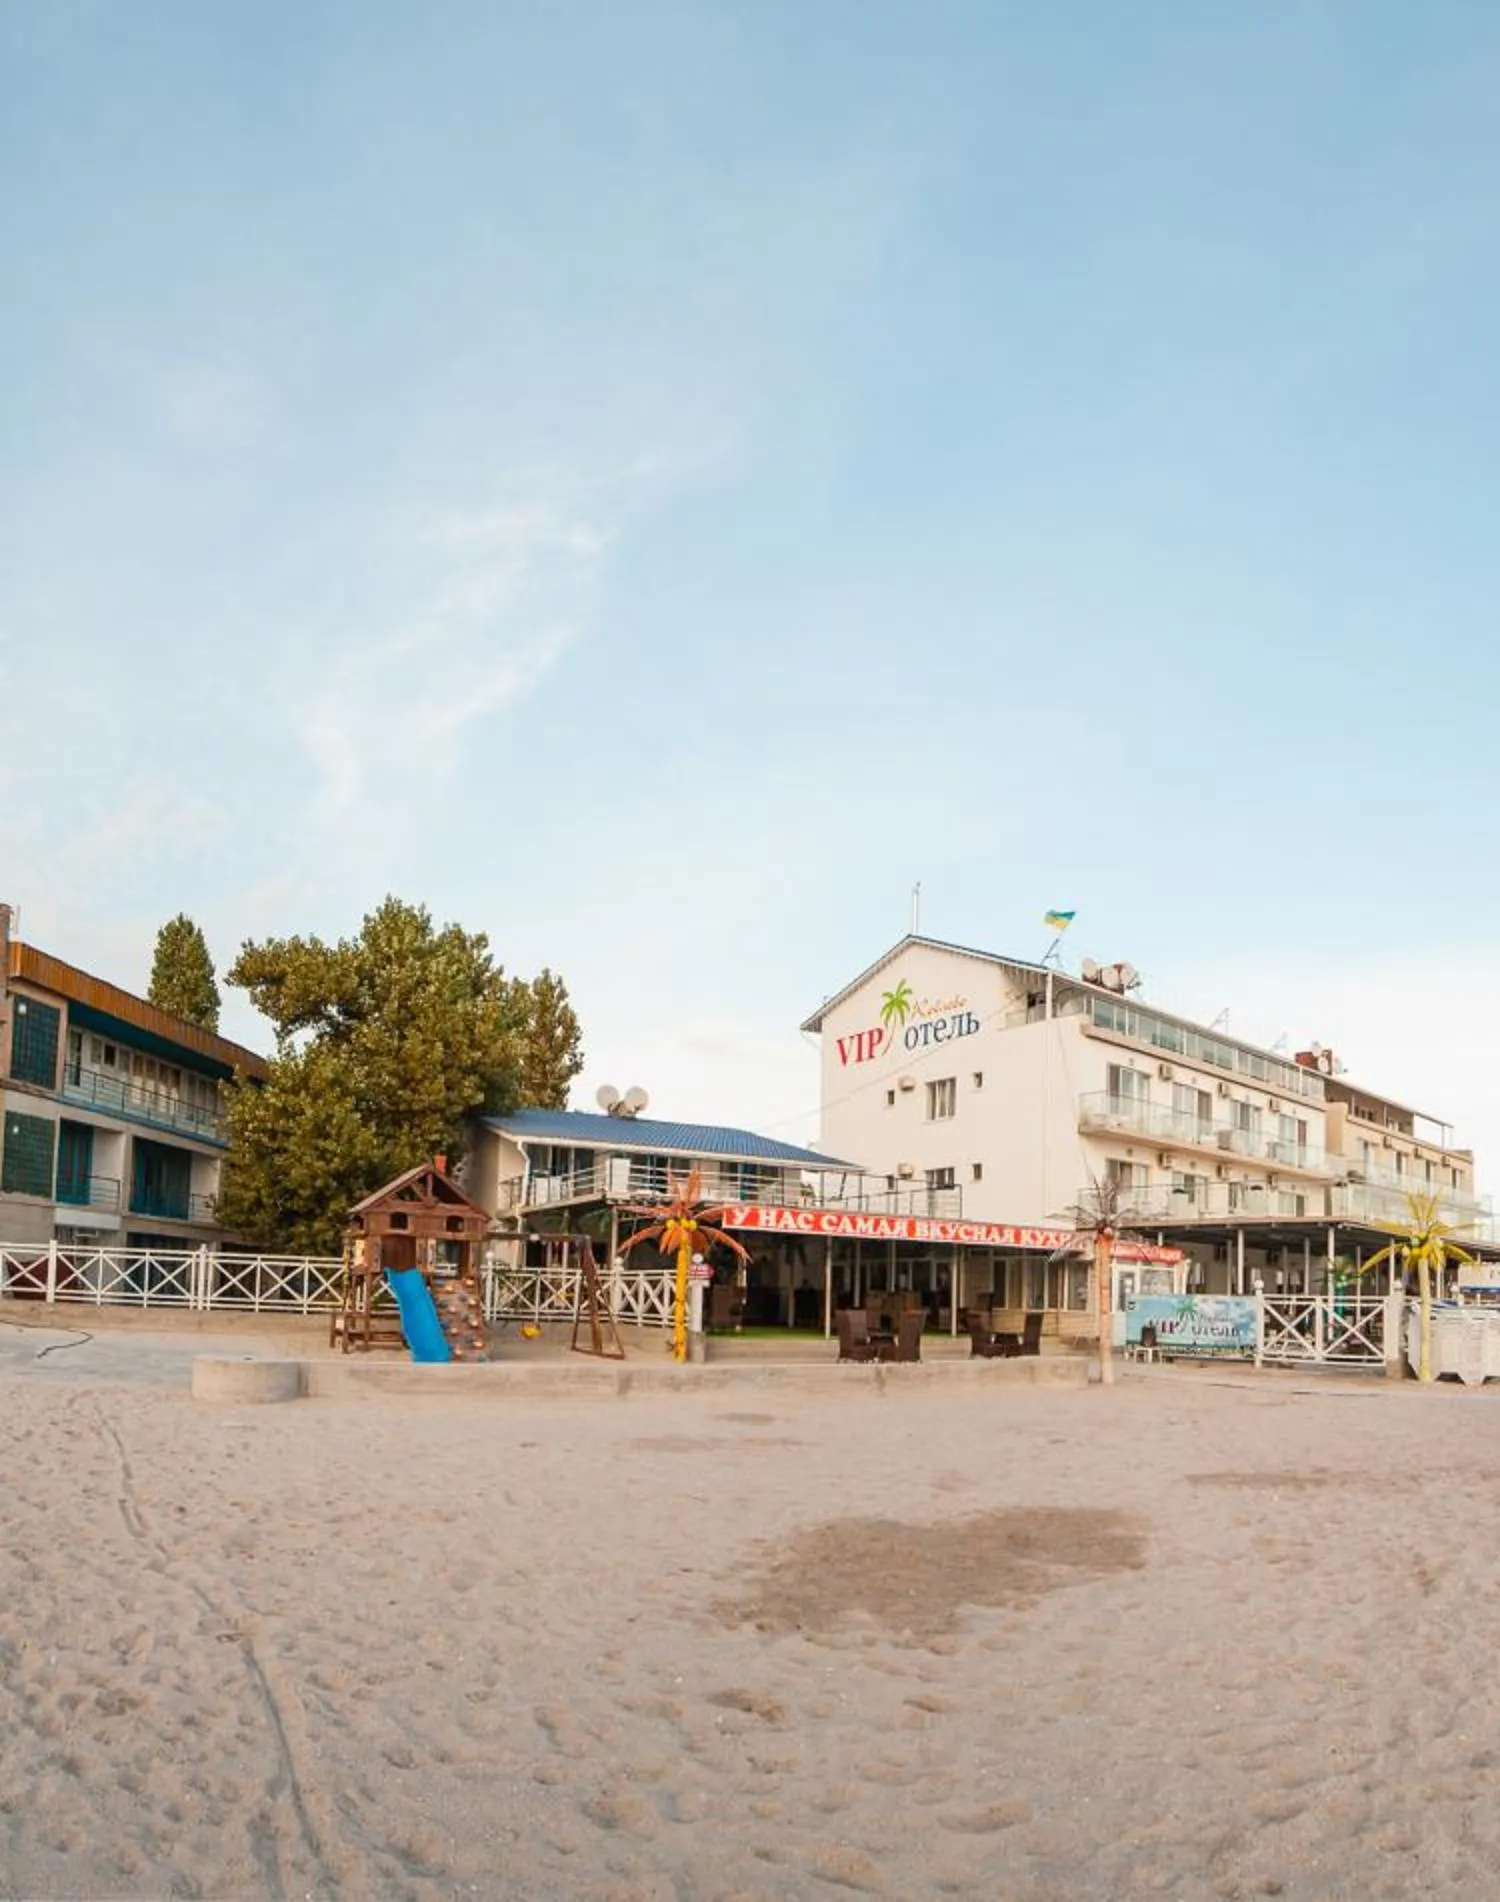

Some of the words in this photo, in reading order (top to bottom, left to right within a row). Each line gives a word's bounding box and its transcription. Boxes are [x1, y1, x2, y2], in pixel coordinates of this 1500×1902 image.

[836, 1028, 883, 1067] VIP
[904, 1011, 980, 1050] отель
[732, 1206, 751, 1226] У
[759, 1208, 815, 1230] НАС
[821, 1214, 906, 1237] САМАЯ
[916, 1219, 1014, 1245] ВКУСНАЯ
[1020, 1228, 1087, 1250] КУХ
